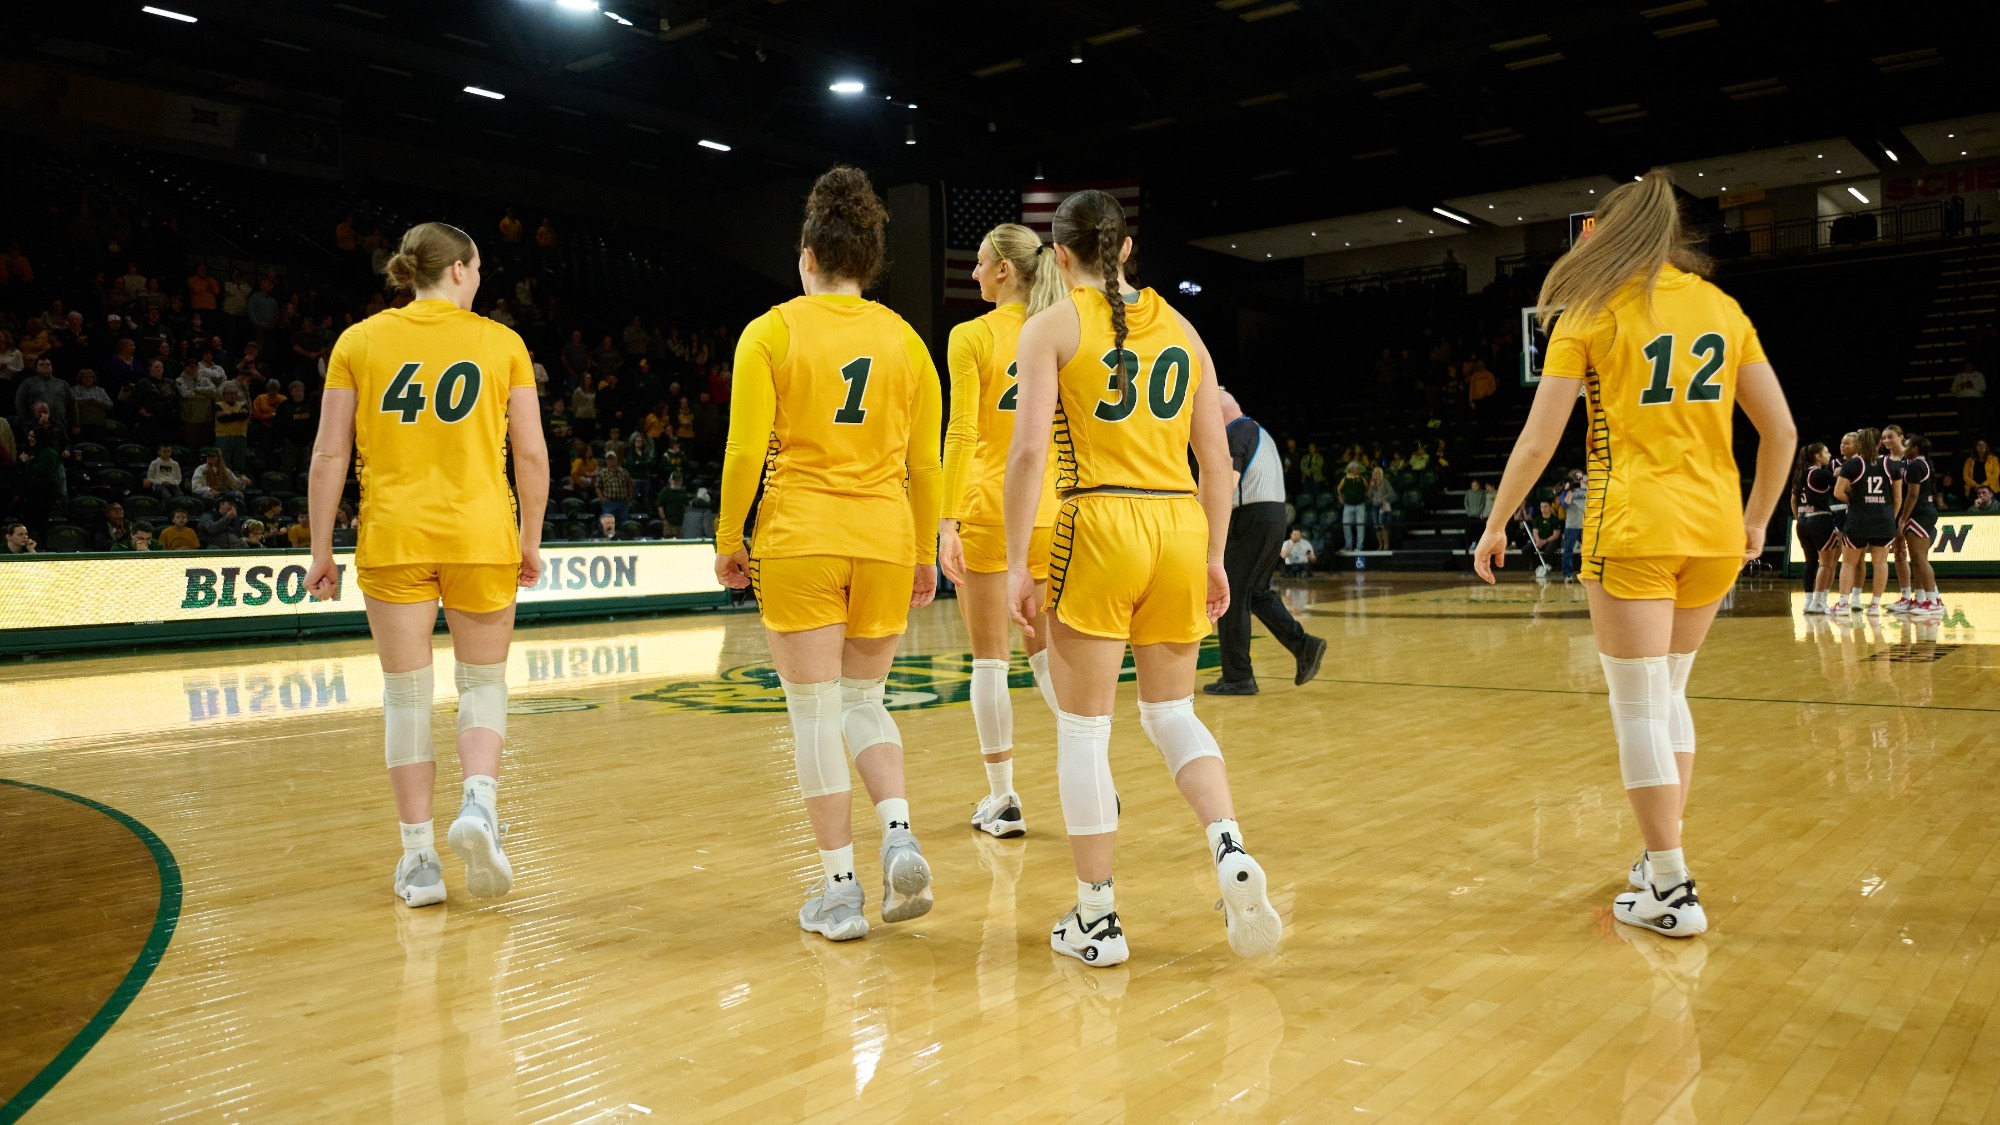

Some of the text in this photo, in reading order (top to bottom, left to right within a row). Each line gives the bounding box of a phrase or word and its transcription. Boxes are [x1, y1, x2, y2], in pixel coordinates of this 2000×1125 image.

[380, 360, 482, 424] 40
[833, 356, 873, 425] 1
[1093, 345, 1190, 423] 30
[1639, 332, 1725, 406] 12
[1866, 476, 1884, 494] 12
[181, 564, 347, 609] BISO
